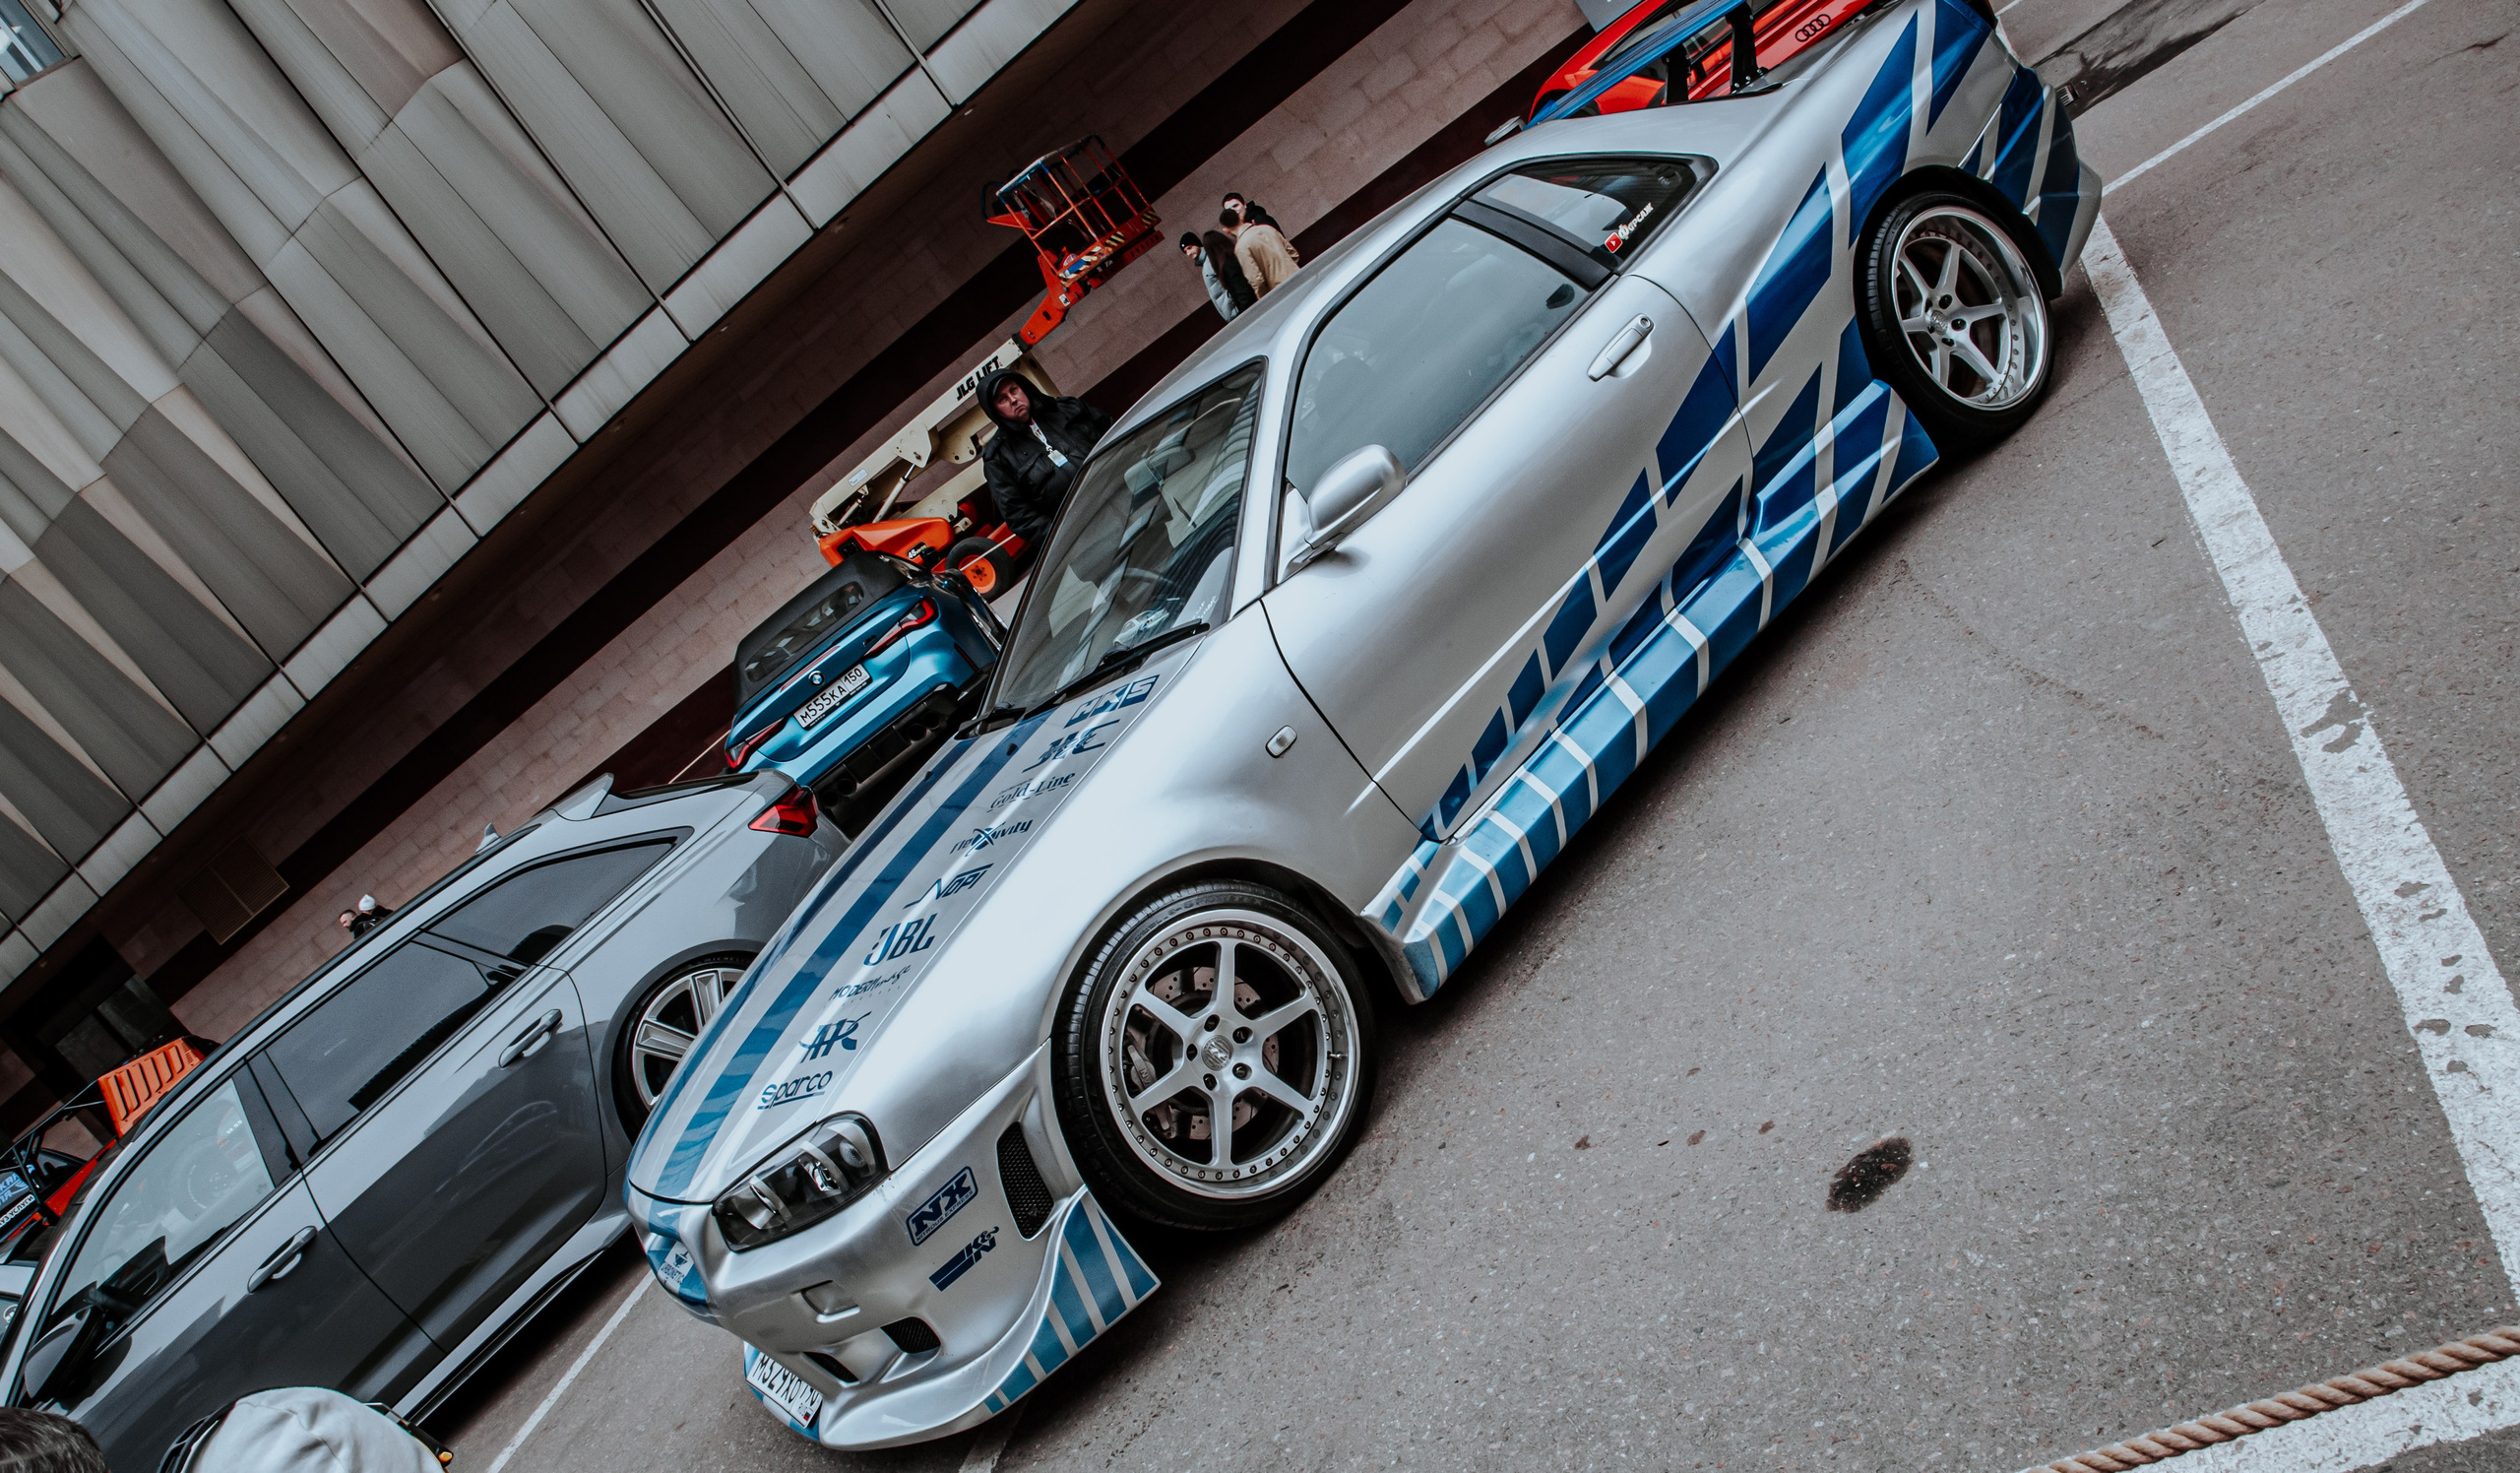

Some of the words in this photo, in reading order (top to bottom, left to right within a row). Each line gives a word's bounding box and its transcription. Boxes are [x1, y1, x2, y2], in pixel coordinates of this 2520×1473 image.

[956, 376, 976, 402] JLG
[976, 355, 999, 382] LIFT
[1063, 673, 1161, 730] HKS
[989, 772, 1076, 810] Gold-Line
[862, 913, 938, 967] JBL
[911, 1172, 972, 1237] NX
